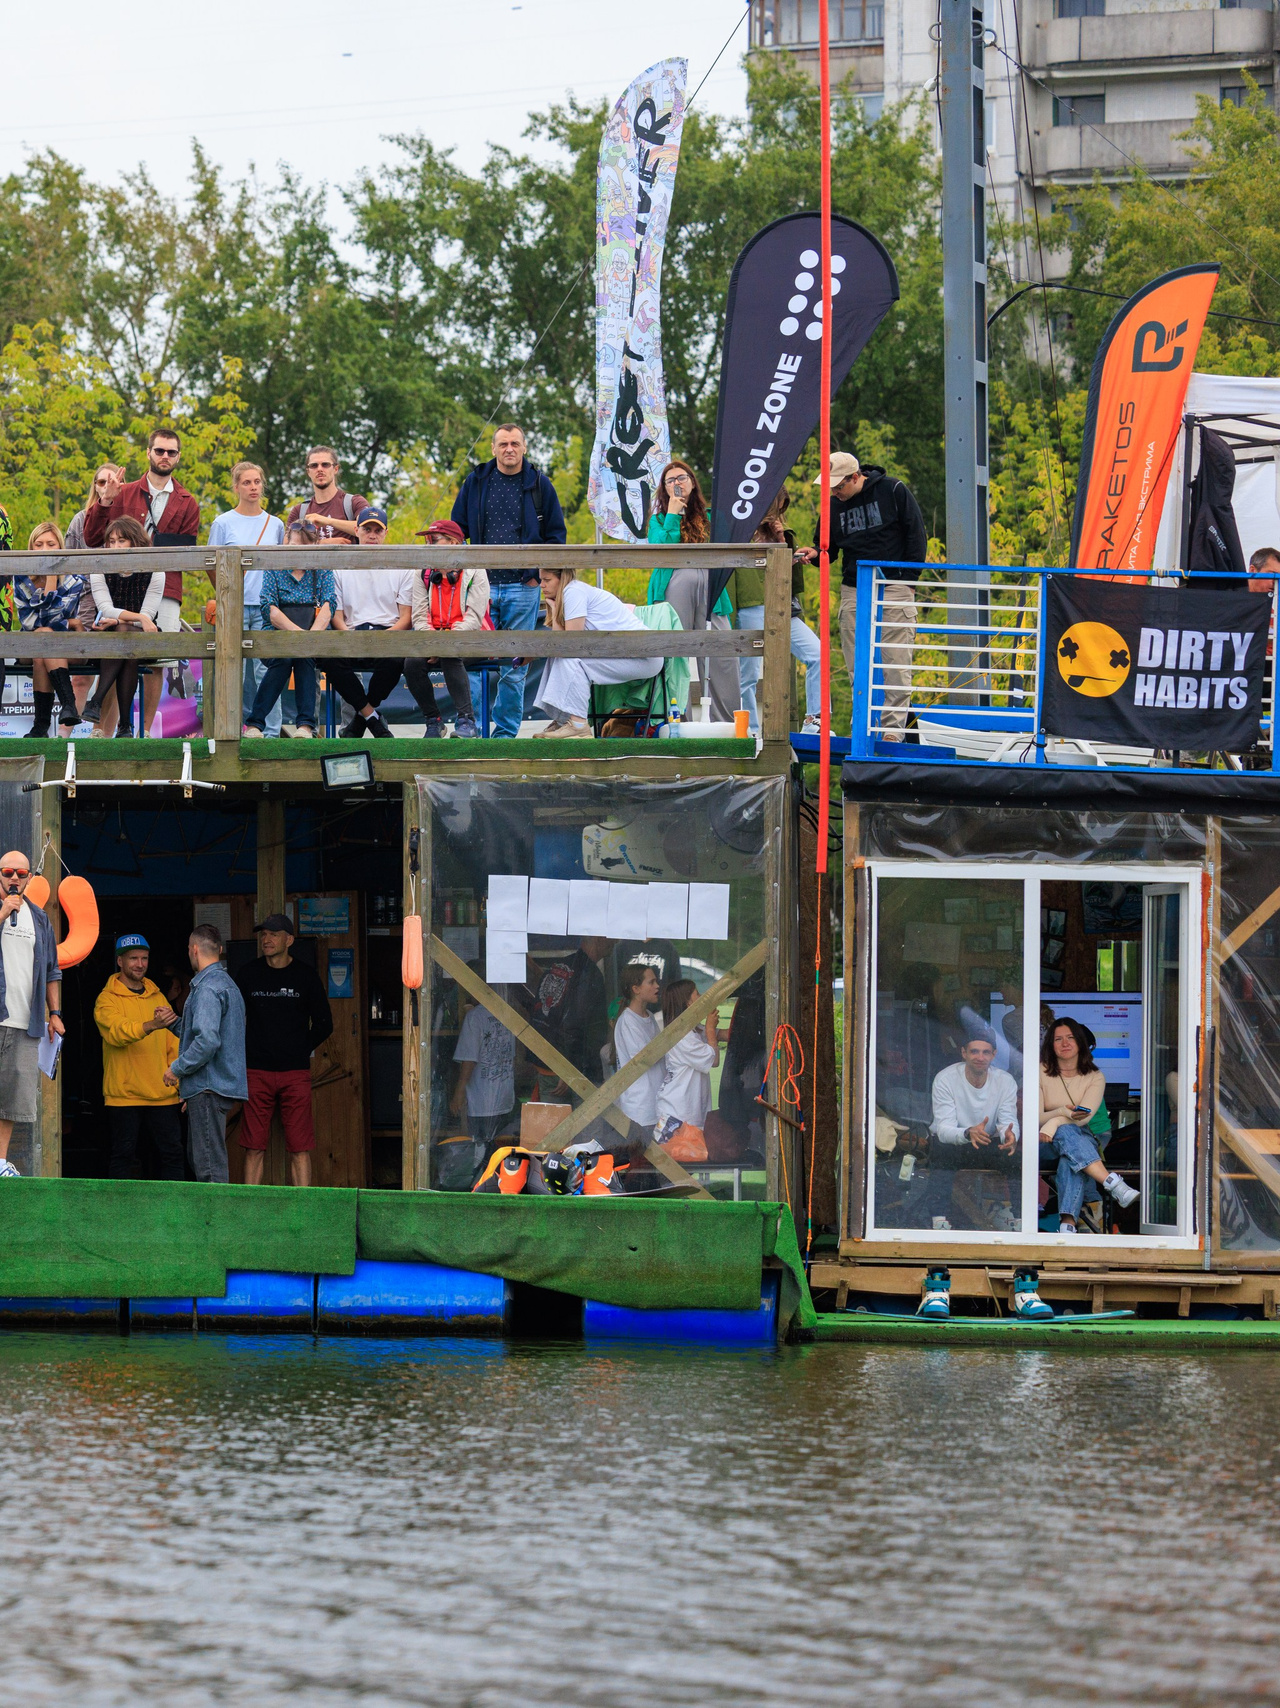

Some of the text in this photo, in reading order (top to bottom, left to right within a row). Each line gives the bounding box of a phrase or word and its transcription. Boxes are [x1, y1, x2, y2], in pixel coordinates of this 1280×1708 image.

[731, 352, 803, 520] COOL ZONE
[1095, 400, 1136, 570] RAKETOS
[1137, 440, 1156, 511] ЭКСТРИМА
[1137, 627, 1255, 671] DIRTY
[1133, 673, 1249, 710] HABITS
